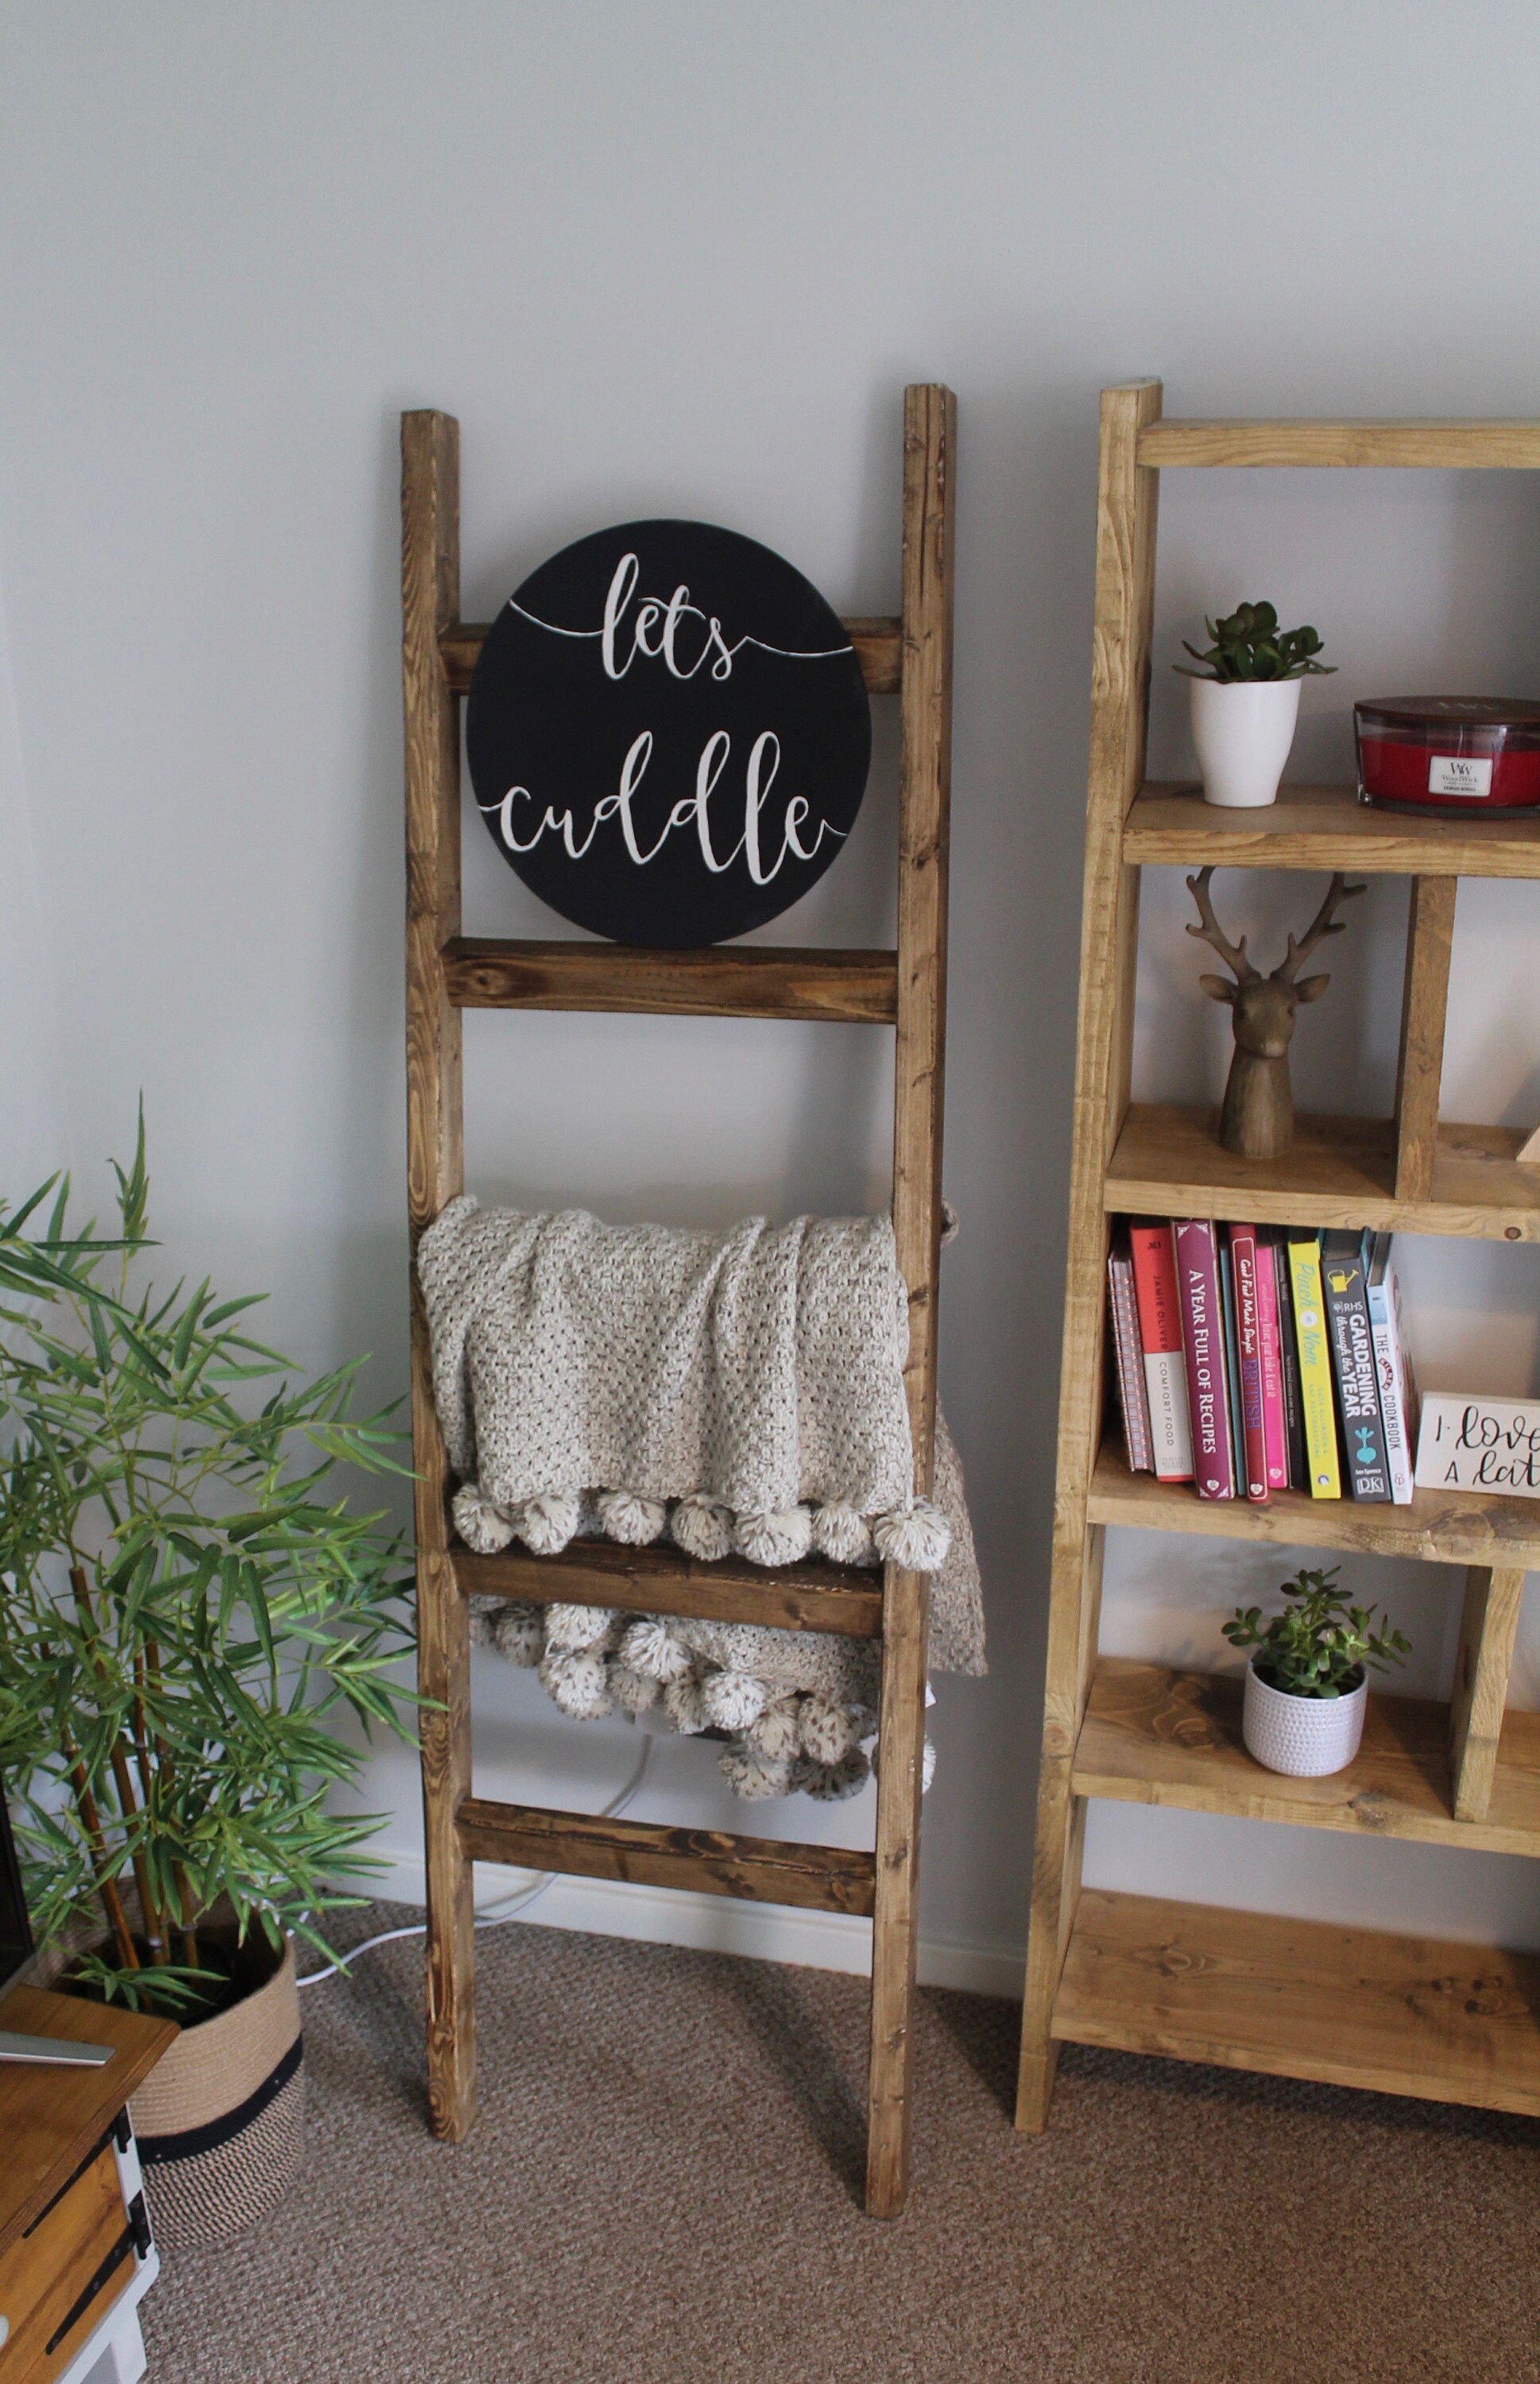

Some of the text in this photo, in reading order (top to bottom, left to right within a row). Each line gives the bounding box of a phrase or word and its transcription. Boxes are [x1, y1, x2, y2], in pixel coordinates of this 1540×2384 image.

[478, 730, 847, 885] cuddle
[1154, 1275, 1168, 1349] JAMIE OLIVER
[1297, 1262, 1318, 1309] Pinch
[1344, 1302, 1364, 1311] RHS
[1189, 1270, 1217, 1453] A YEAR FULL OF RECIPES
[1240, 1259, 1261, 1429] Good Food Made Simple BRITISH
[1302, 1329, 1321, 1365] Nom
[1337, 1316, 1361, 1418] through the YEAR
[1348, 1314, 1377, 1416] GARDENING
[1159, 1361, 1171, 1412] COMFORT
[1165, 1417, 1174, 1446] FOOD
[1376, 1333, 1389, 1353] THE
[1383, 1395, 1402, 1449] COOKBOOK
[1436, 1406, 1540, 1452] I love
[1359, 1477, 1381, 1492] DK
[1445, 1461, 1460, 1483] A
